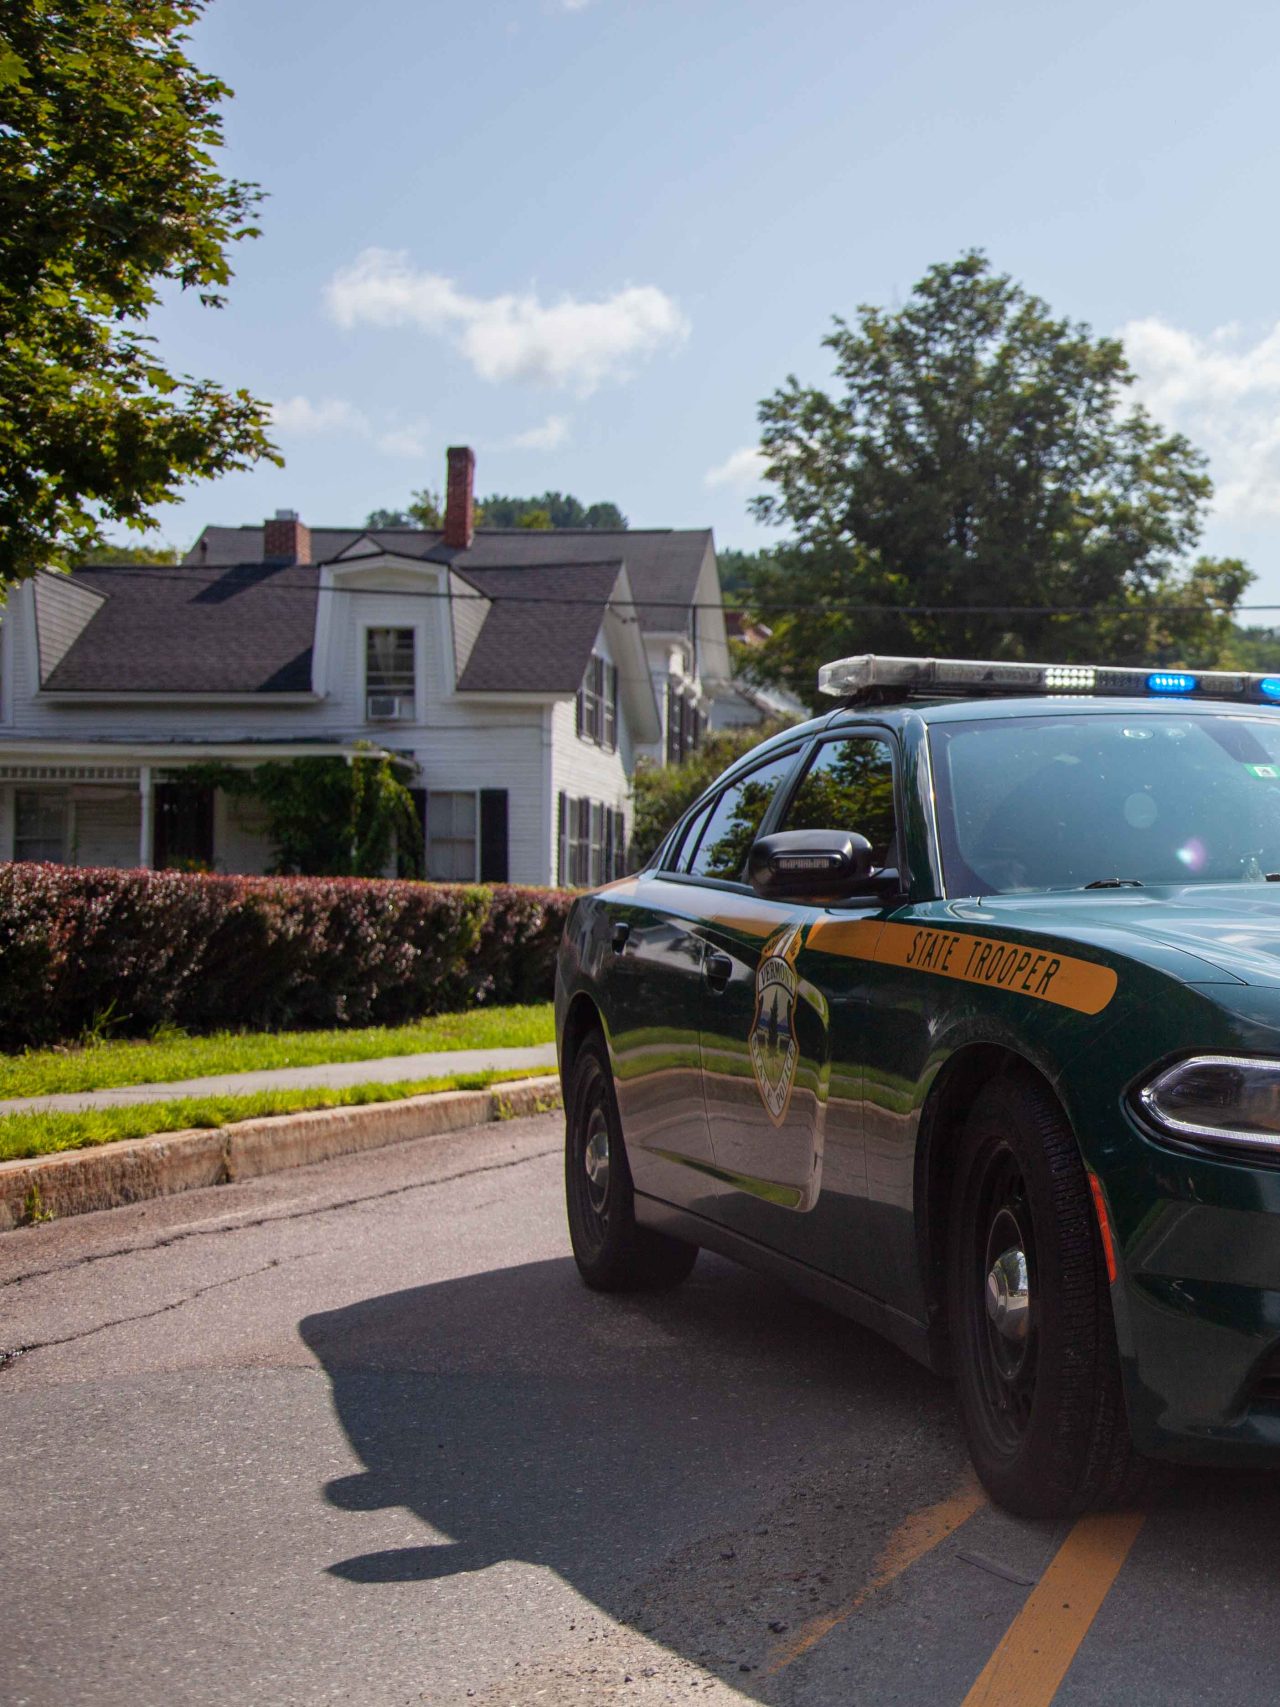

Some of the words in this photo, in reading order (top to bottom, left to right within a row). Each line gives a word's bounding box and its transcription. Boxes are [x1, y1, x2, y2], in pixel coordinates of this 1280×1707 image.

[760, 960, 795, 992] VERMONT
[906, 930, 960, 972] STATE
[963, 940, 1061, 996] TROOPER
